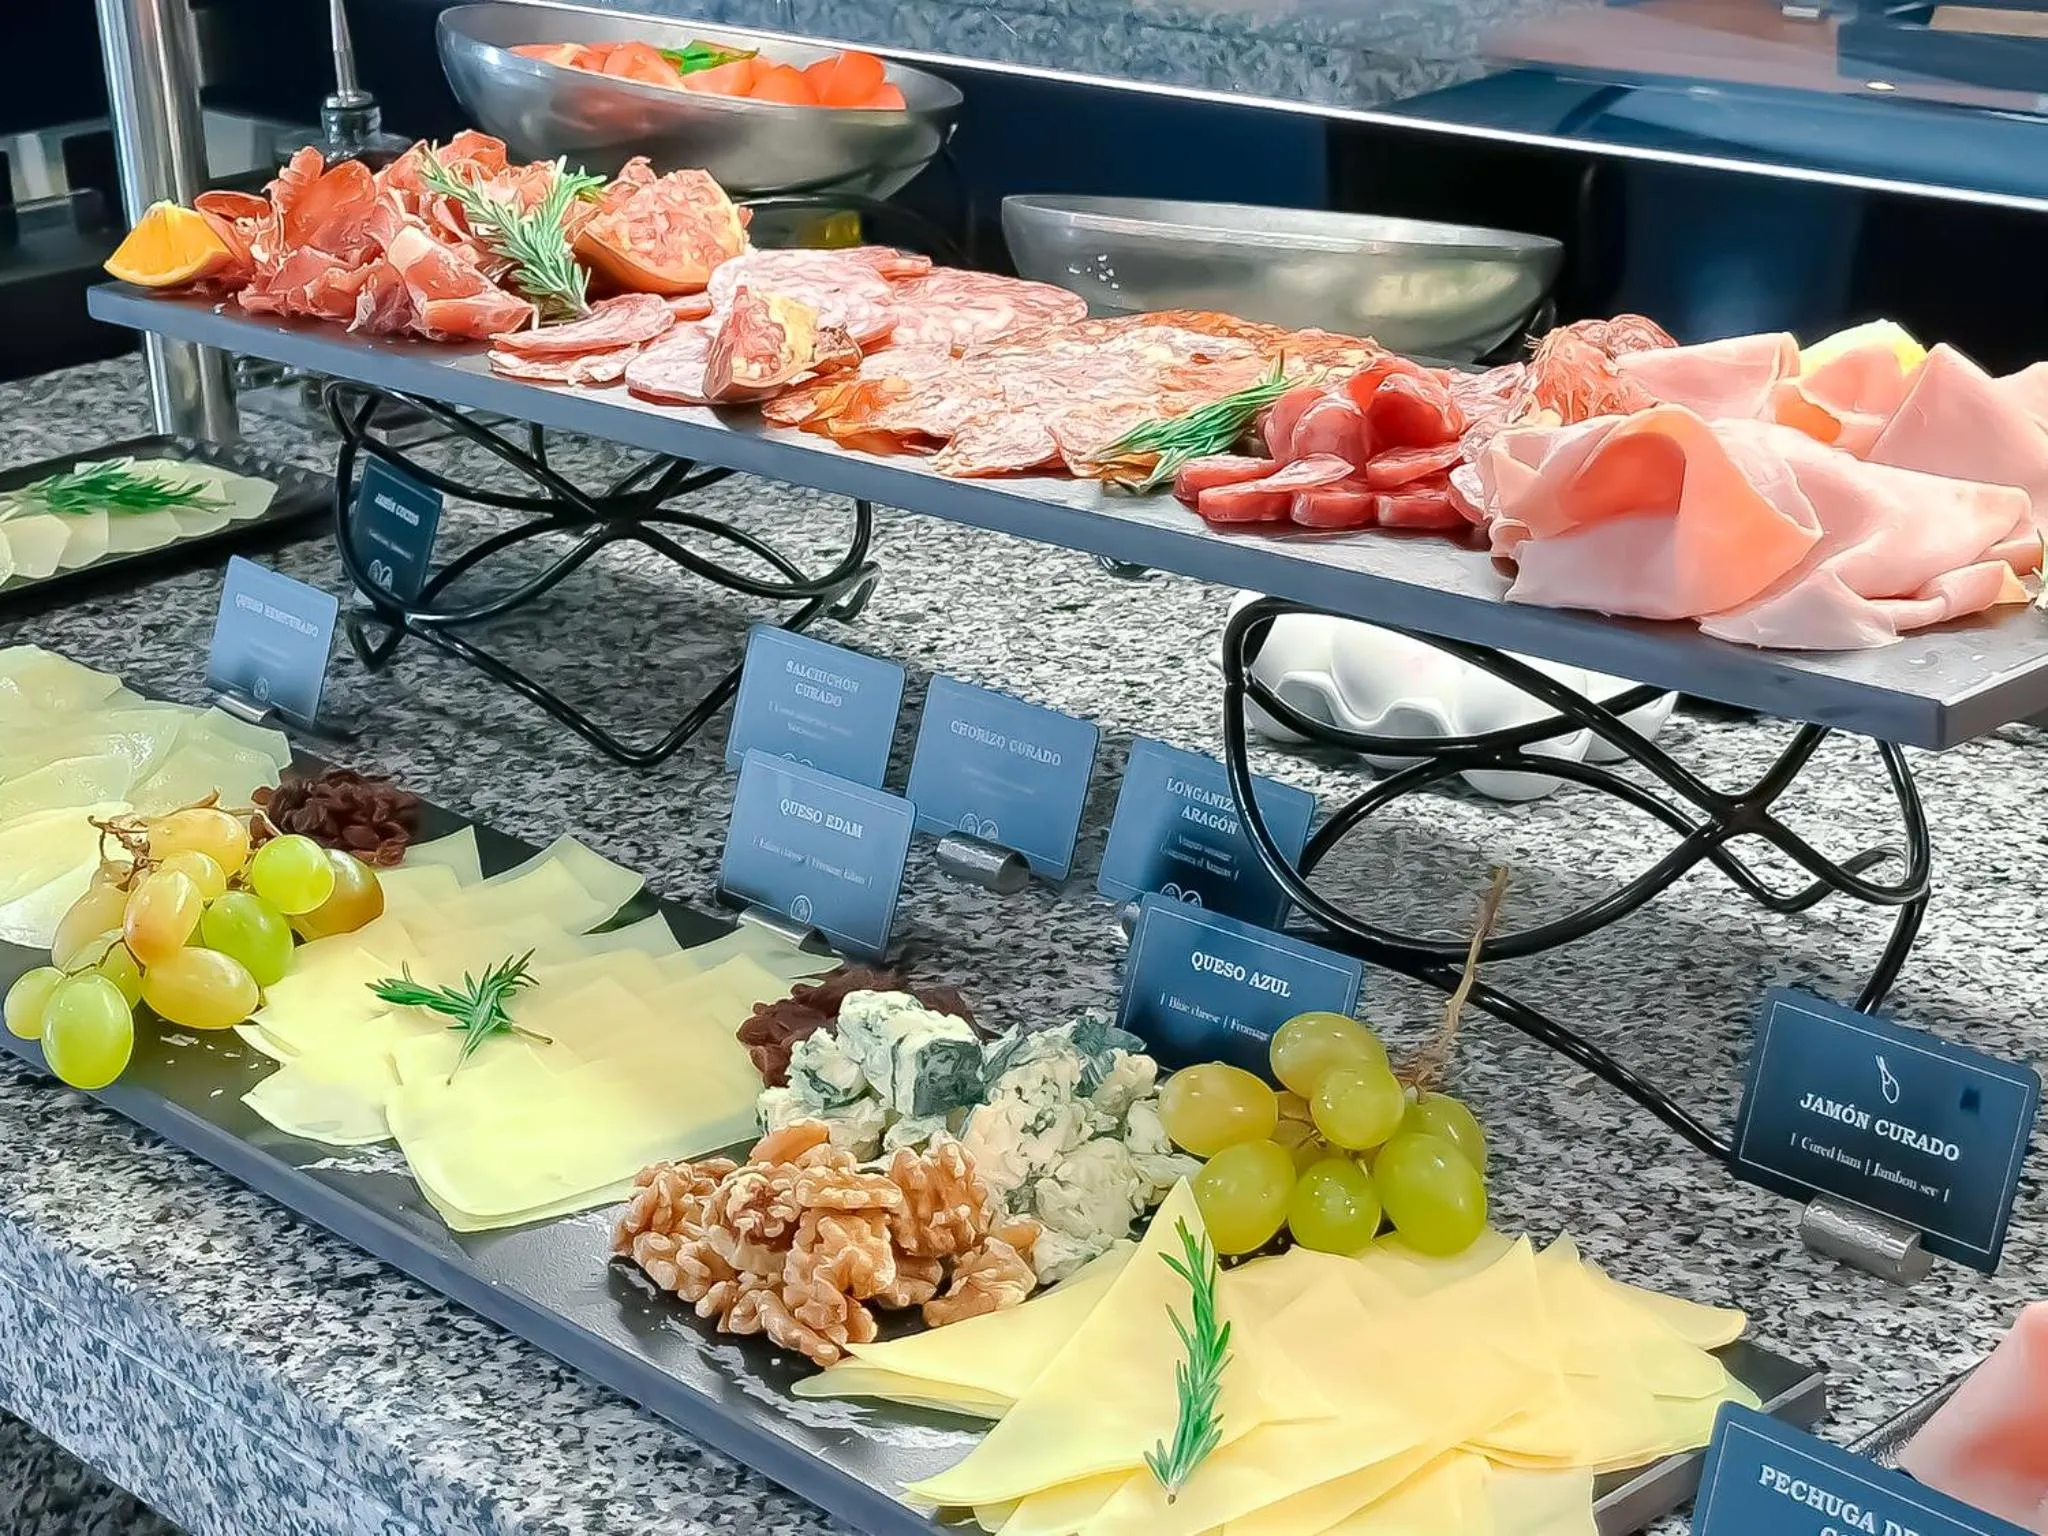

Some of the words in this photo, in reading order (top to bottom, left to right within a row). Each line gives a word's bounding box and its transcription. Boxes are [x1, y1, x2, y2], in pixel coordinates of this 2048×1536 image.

[795, 682, 842, 707] CURADO
[950, 719, 1006, 749] CHORIZO
[1008, 739, 1062, 766] CURADO
[1166, 778, 1237, 814] LONGANIZ
[780, 798, 823, 823] QUESO
[825, 813, 863, 838] EDAM
[1181, 804, 1238, 835] ARAGÓN
[1191, 951, 1246, 981] QUESO
[1248, 971, 1291, 998] AZUL
[1800, 1092, 1871, 1130] JAMÓN
[1874, 1119, 1960, 1161] CURADO
[1801, 1136, 1836, 1159] Cured
[1837, 1149, 1861, 1170] ham
[1758, 1464, 1875, 1534] PECHUGA
